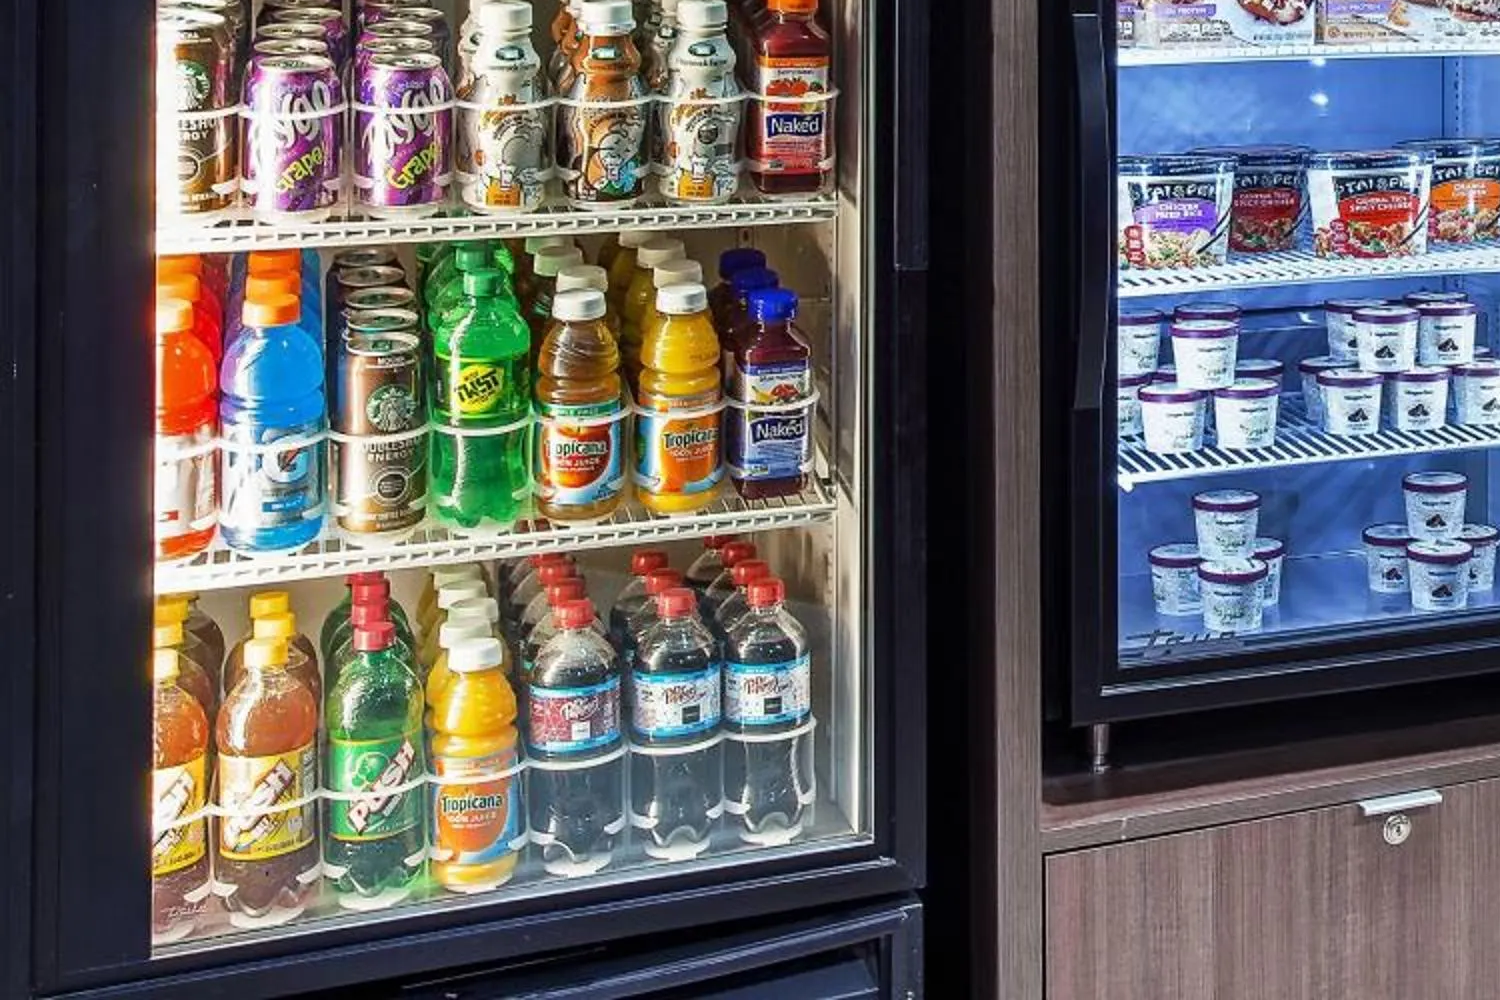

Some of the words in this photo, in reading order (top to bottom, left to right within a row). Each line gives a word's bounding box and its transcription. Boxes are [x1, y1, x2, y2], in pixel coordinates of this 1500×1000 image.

[771, 115, 820, 133] Naked
[756, 418, 804, 440] Naked
[545, 438, 609, 459] opicana
[442, 794, 503, 813] Tropicana
